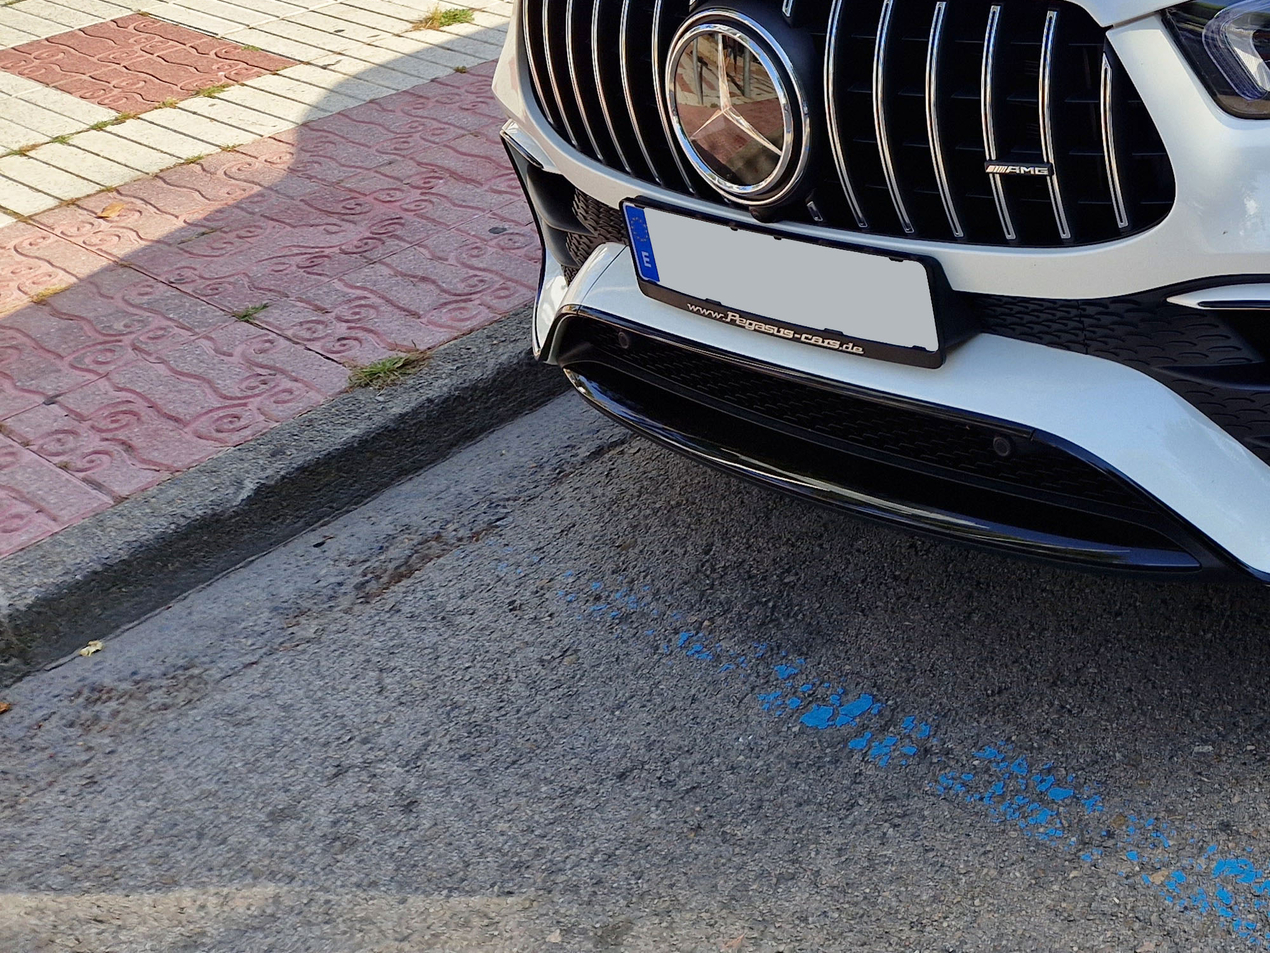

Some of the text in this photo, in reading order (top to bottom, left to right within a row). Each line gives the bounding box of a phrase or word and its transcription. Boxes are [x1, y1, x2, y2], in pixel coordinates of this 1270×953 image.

[1004, 165, 1049, 175] AMG
[642, 251, 652, 268] E
[687, 303, 865, 355] www.Pegasus-cars.de
